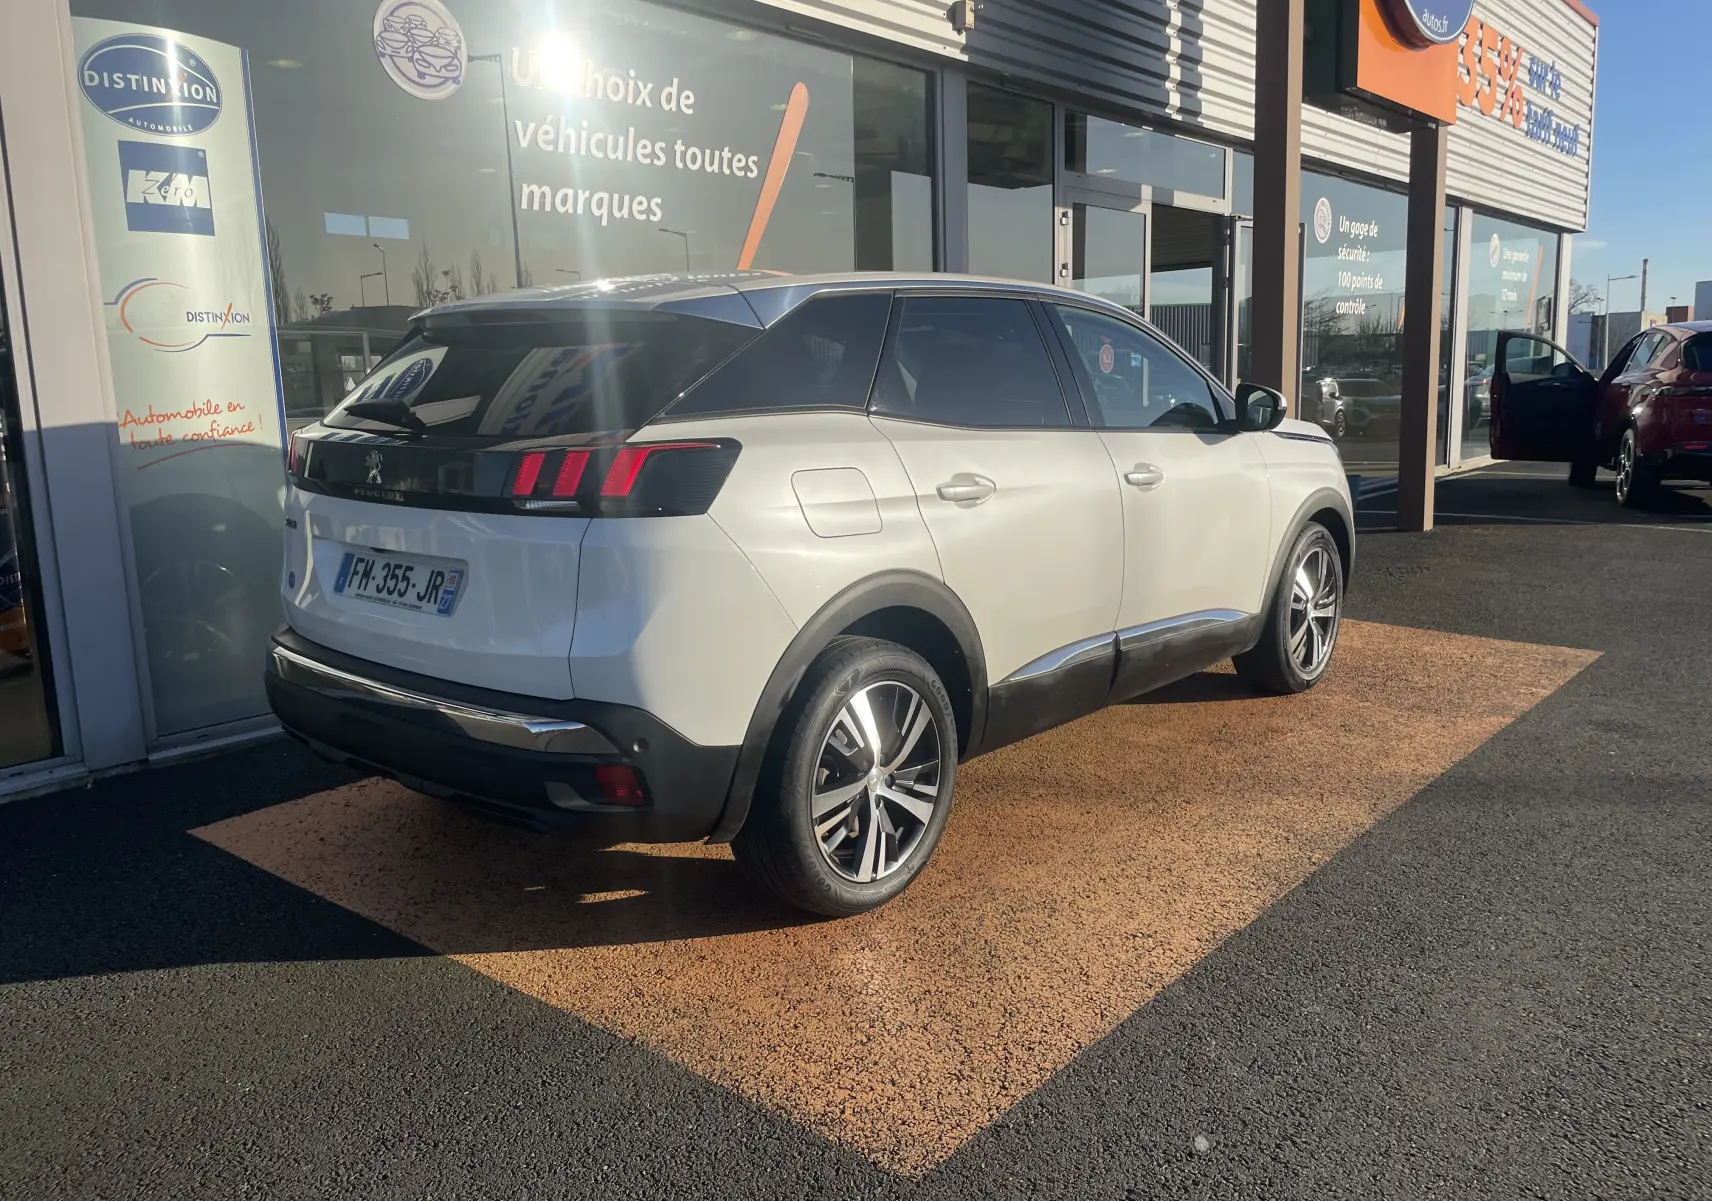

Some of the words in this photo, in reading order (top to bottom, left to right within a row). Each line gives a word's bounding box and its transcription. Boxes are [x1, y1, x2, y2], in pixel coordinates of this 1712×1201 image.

[1422, 8, 1449, 33] autos.fr
[566, 59, 654, 109] hoix
[660, 77, 695, 115] de
[128, 117, 194, 132] AUTOMOBILE
[514, 114, 666, 167] véhicules
[673, 139, 759, 179] toutes
[520, 181, 663, 226] marques
[1339, 215, 1349, 233] Un
[1350, 221, 1369, 240] gage
[1369, 220, 1378, 238] de
[1337, 270, 1352, 288] 100
[1351, 272, 1374, 292] points
[1374, 273, 1383, 290] de
[186, 303, 250, 328] DISTINXION
[1336, 298, 1366, 315] contrôle
[118, 399, 222, 428] Automobile
[227, 400, 245, 412] en
[131, 427, 173, 450] toute
